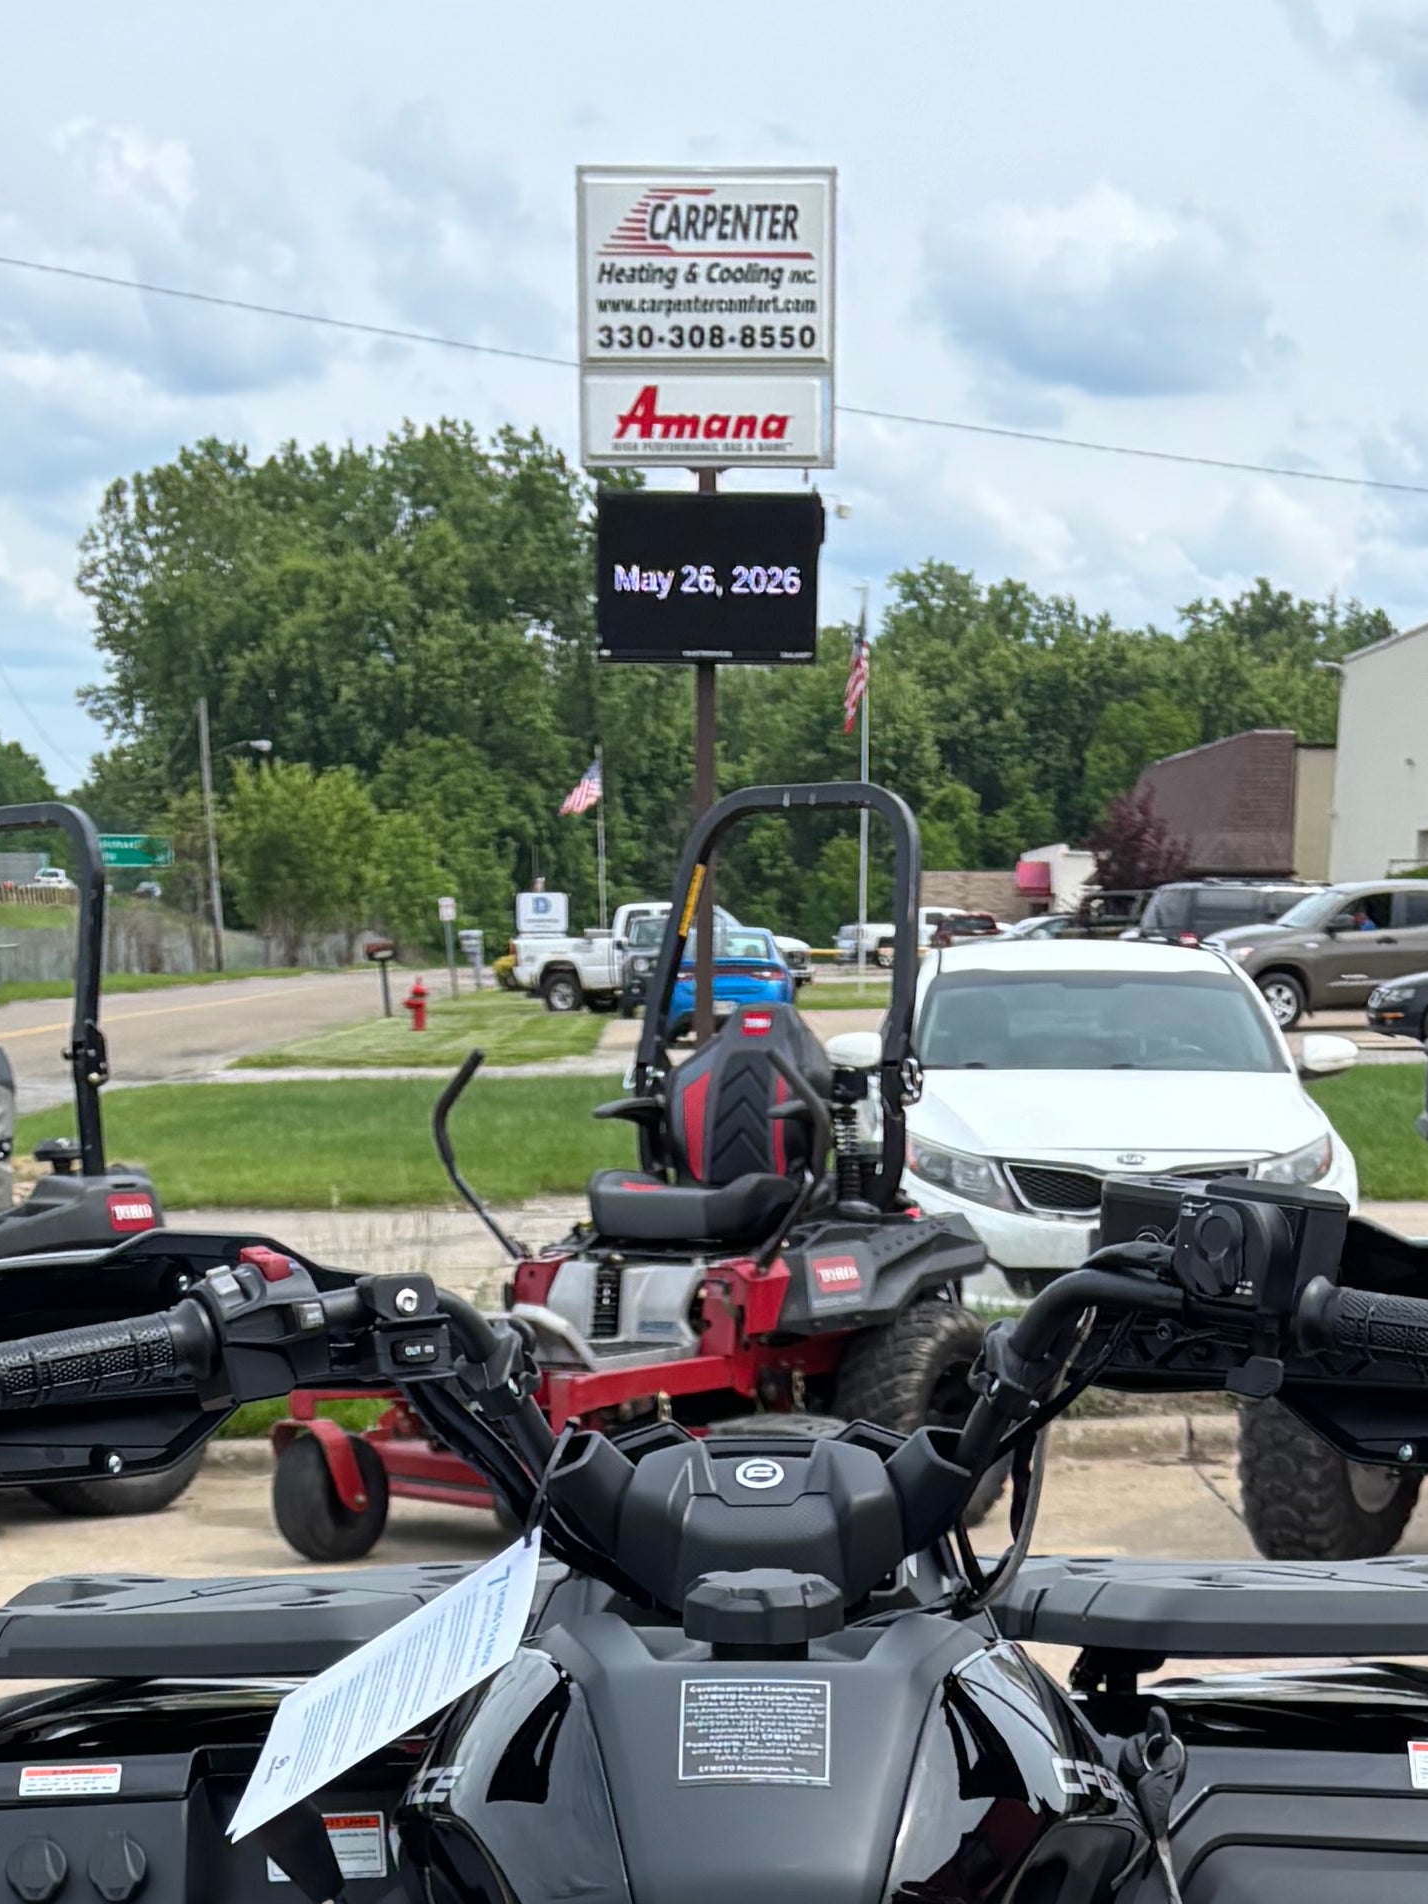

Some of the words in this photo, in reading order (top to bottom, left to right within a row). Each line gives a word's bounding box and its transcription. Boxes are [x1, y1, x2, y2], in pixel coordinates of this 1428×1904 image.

[648, 203, 799, 241] CARPENTER
[597, 262, 678, 289] Heating
[683, 263, 700, 283] &
[705, 262, 785, 289] Cooling
[612, 384, 793, 440] Amana
[613, 564, 675, 600] May
[680, 564, 723, 598] 26,
[730, 565, 802, 595] 2026
